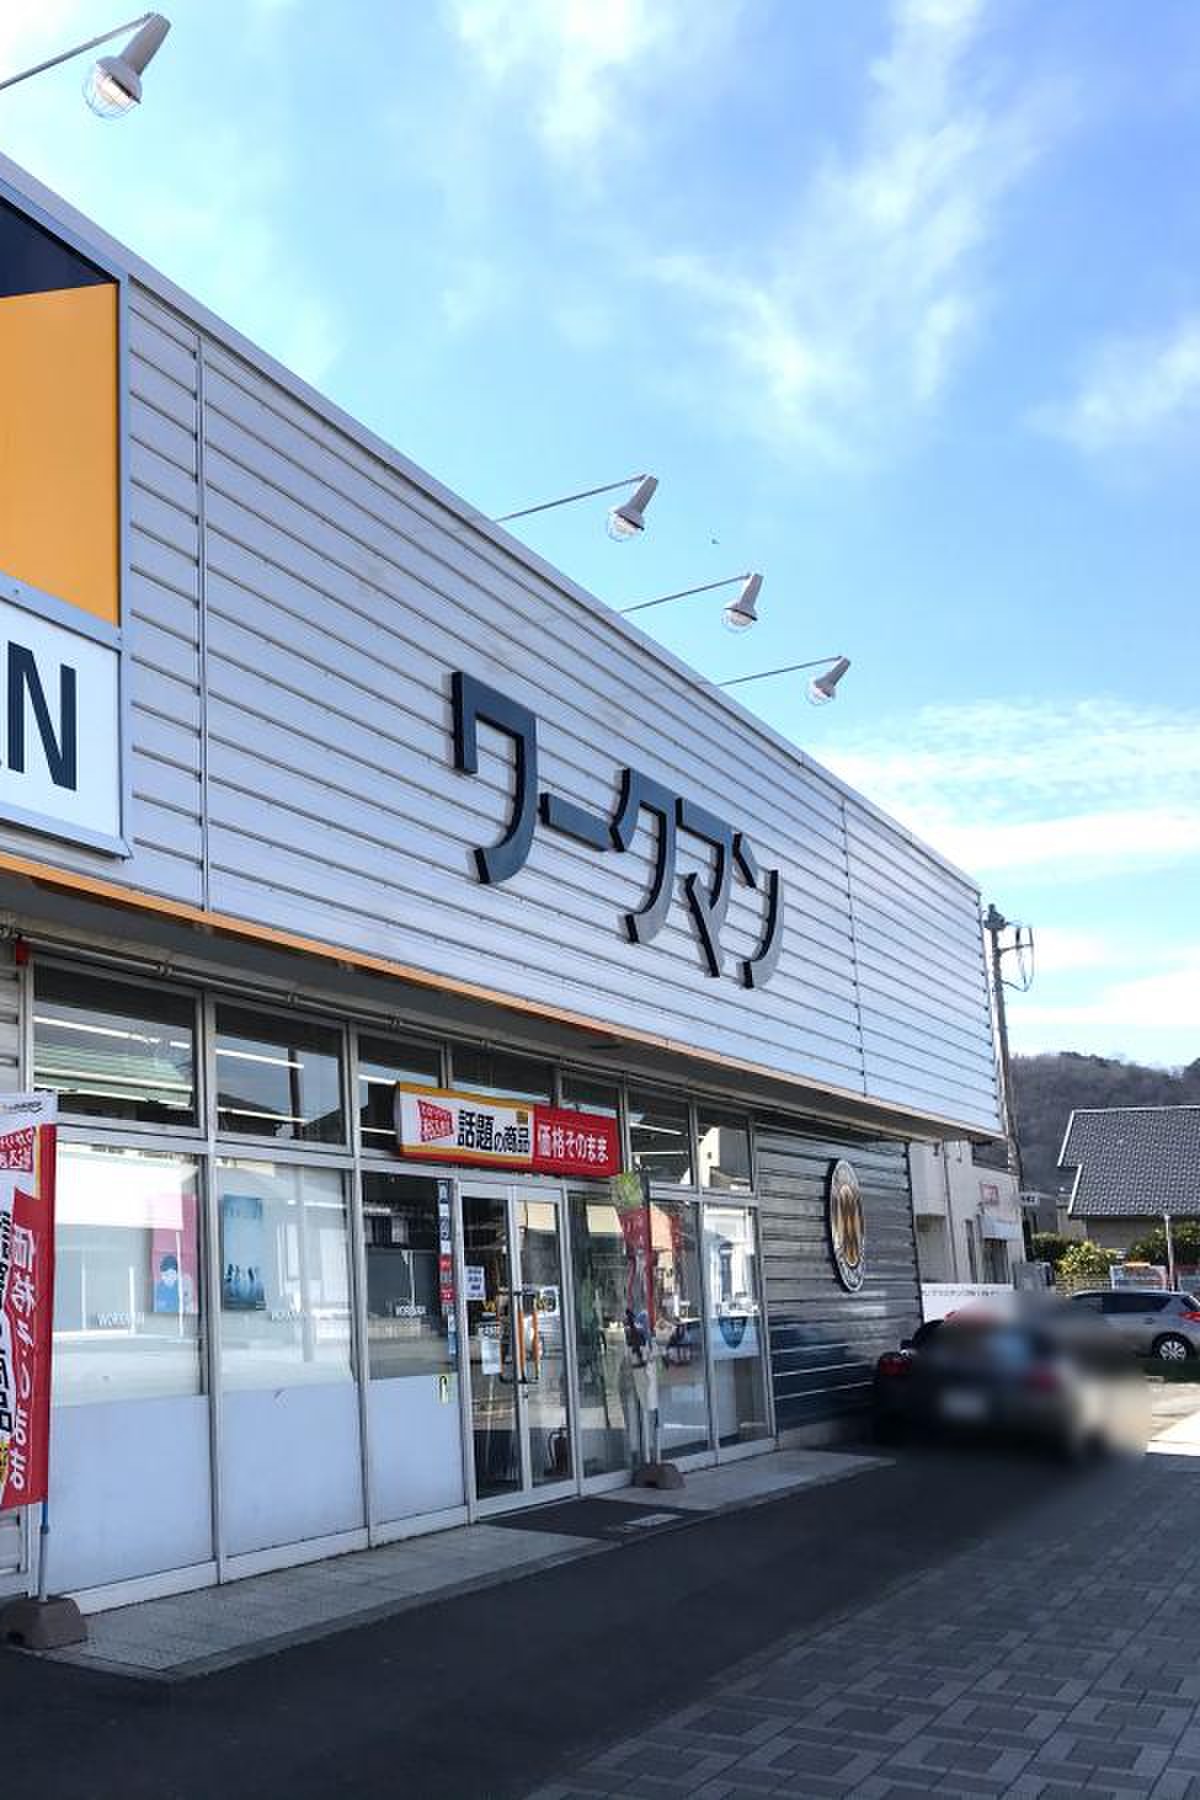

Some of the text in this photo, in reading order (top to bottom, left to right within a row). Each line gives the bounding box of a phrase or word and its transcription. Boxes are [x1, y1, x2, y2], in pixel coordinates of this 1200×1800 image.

[449, 671, 784, 990] ワークマン
[457, 1109, 530, 1153] 話題の商品
[537, 1123, 609, 1164] 価格そのまま
